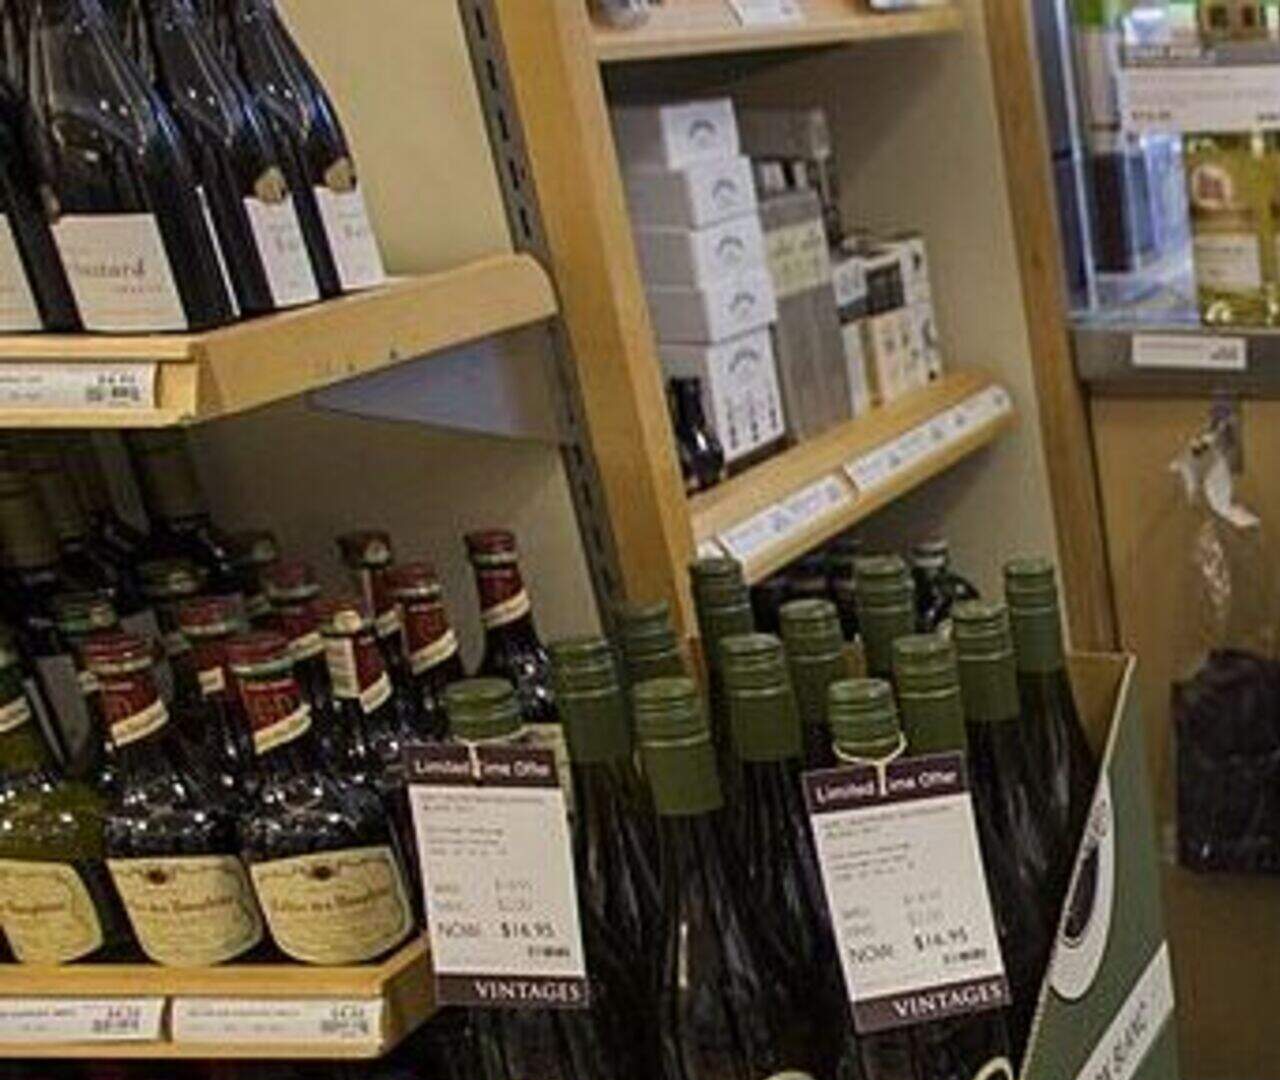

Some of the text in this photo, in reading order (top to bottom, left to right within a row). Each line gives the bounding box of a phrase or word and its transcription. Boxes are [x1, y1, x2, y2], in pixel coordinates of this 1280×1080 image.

[414, 759, 471, 775] Limited
[513, 760, 551, 777] Offer
[814, 781, 875, 804] Limited
[917, 769, 958, 788] Offer
[473, 980, 582, 1001] VINTAGES
[892, 983, 1005, 1018] VINTAGES
